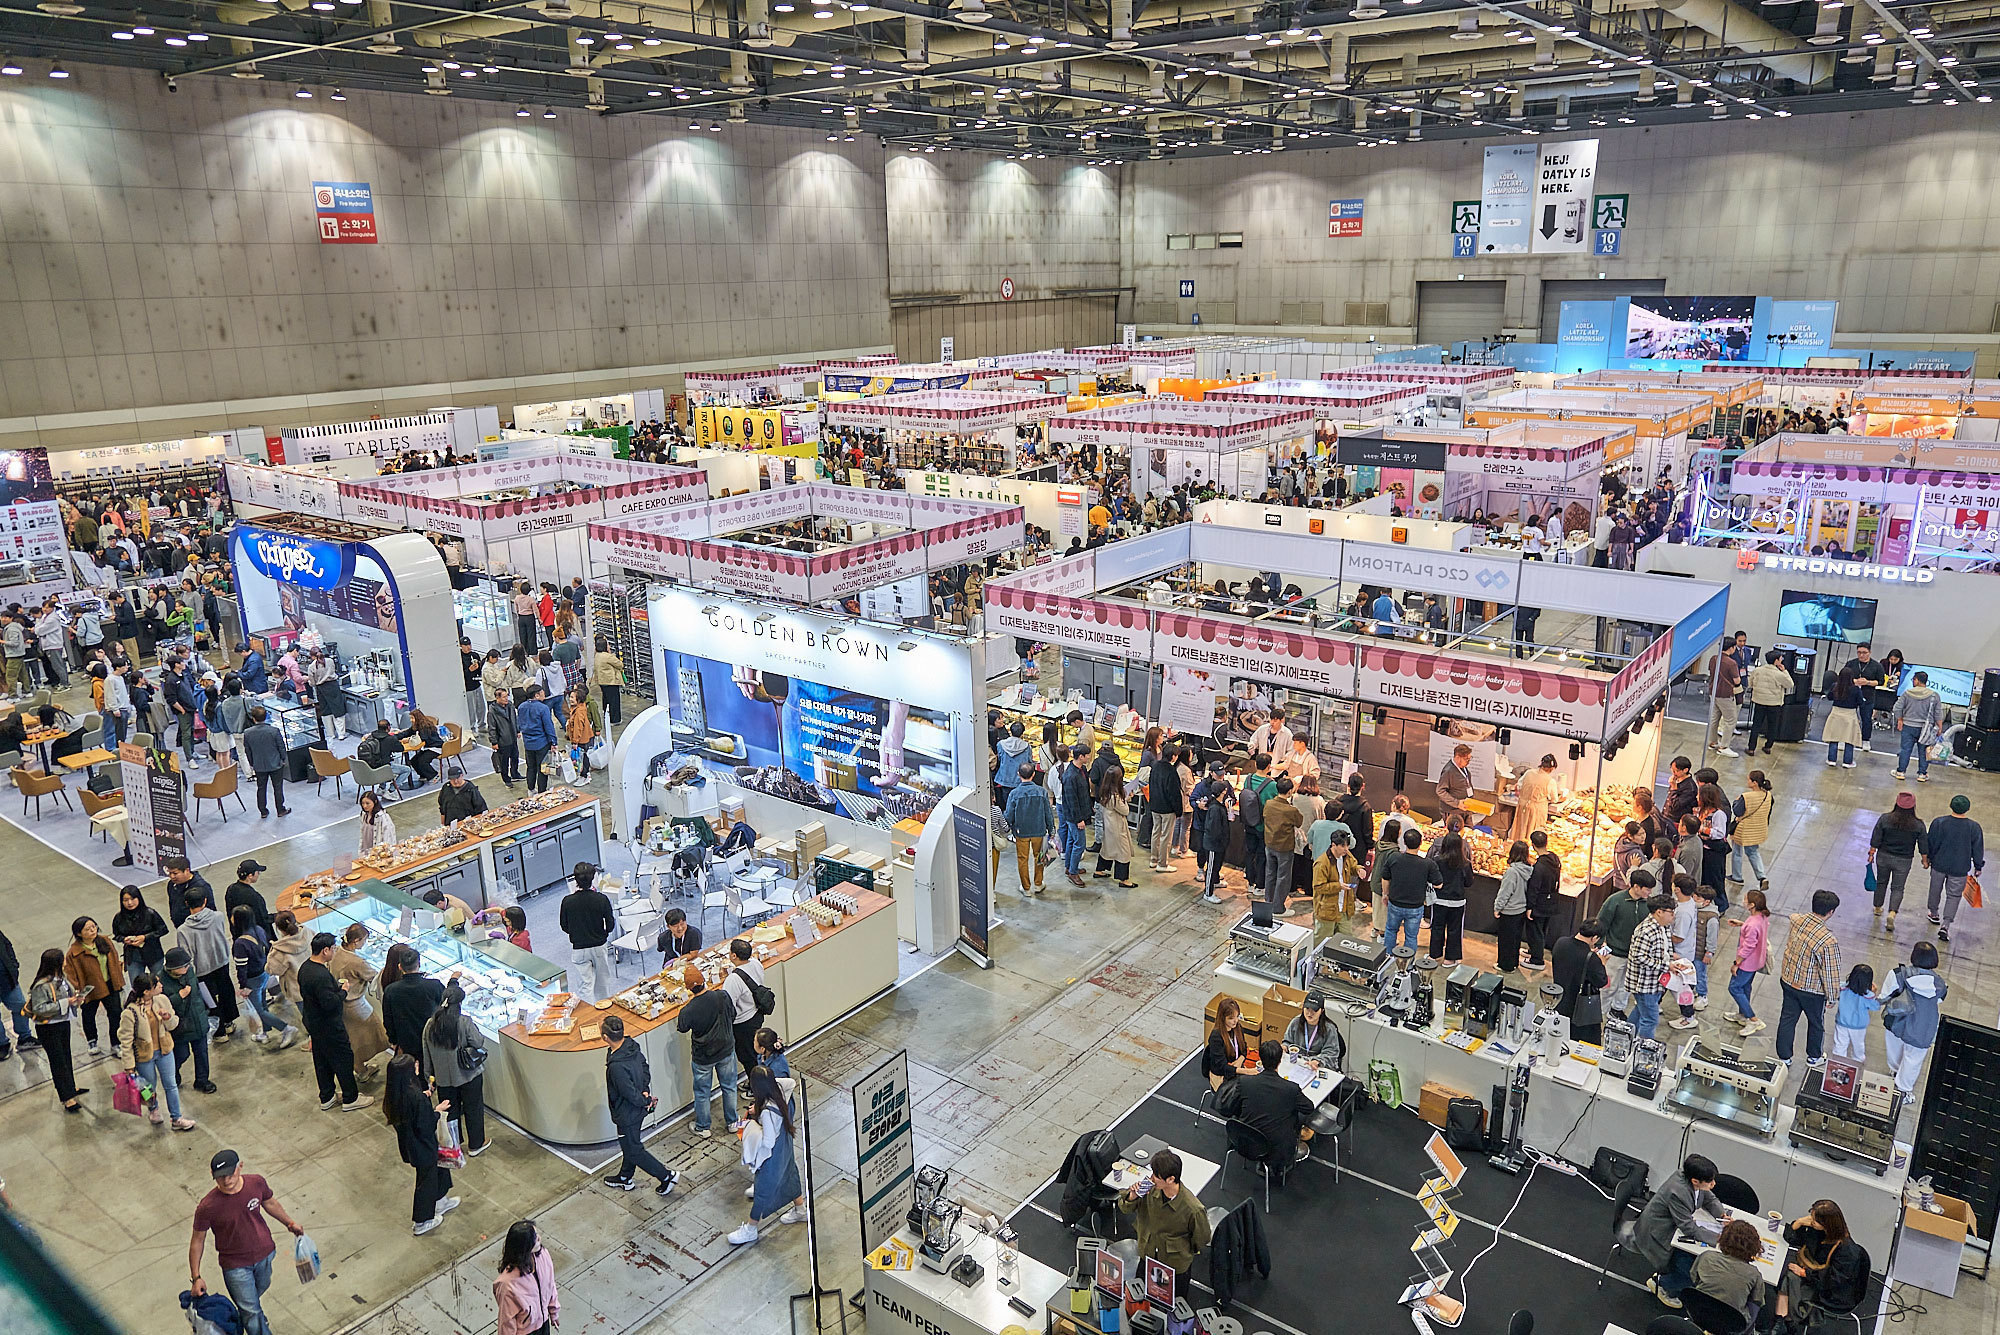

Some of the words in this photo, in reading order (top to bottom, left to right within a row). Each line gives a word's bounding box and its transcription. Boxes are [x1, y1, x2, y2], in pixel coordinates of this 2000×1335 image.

[1544, 155, 1569, 166] HEJ!
[1543, 169, 1577, 180] OATLY
[1581, 168, 1591, 178] IS
[1487, 187, 1529, 195] CHAMPIONSHIP
[1541, 183, 1573, 194] HERE.
[342, 220, 370, 229] 소화기
[1458, 235, 1472, 246] 10
[1601, 232, 1615, 244] 10
[1460, 248, 1470, 256] A1
[1602, 245, 1613, 253] A2
[1909, 362, 1933, 370] LATTE
[344, 436, 411, 456] TABLES
[960, 487, 1020, 504] trading
[1949, 494, 1973, 506] 수제
[621, 501, 644, 514] CAFE
[645, 497, 667, 510] EXPO
[668, 493, 693, 505] CHINA
[517, 513, 573, 533] (주)건우에프피
[607, 555, 630, 566] WOOJUNG
[1764, 555, 1934, 583] STRONGHOLD
[711, 574, 738, 586] WOOJUNG
[832, 580, 862, 593] WOOJUNG
[708, 612, 794, 642] GOLDEN
[807, 631, 888, 662] BROWN
[999, 615, 1131, 648] 디저트납품전문기업(주)지에프푸드
[1228, 634, 1243, 642] seoul
[1257, 638, 1277, 649] bakery
[1276, 641, 1288, 650] fair
[1125, 650, 1142, 658] B-117
[794, 657, 827, 670] PARTNER
[1171, 645, 1330, 684] 디저트납품전문기업(주)지에프푸드
[1434, 667, 1450, 676] 2023
[1449, 670, 1467, 680] seoul
[1485, 675, 1508, 687] bakery
[1507, 678, 1522, 688] fair
[1323, 686, 1343, 695] B-117
[1924, 680, 1939, 690] 021
[1940, 684, 1963, 698] Korea
[1379, 682, 1574, 727] 디저트납품전문기업(주)지에프푸드
[1565, 728, 1589, 739] B-117
[869, 1108, 902, 1146] 잡아라
[872, 1288, 912, 1322] TEAM
